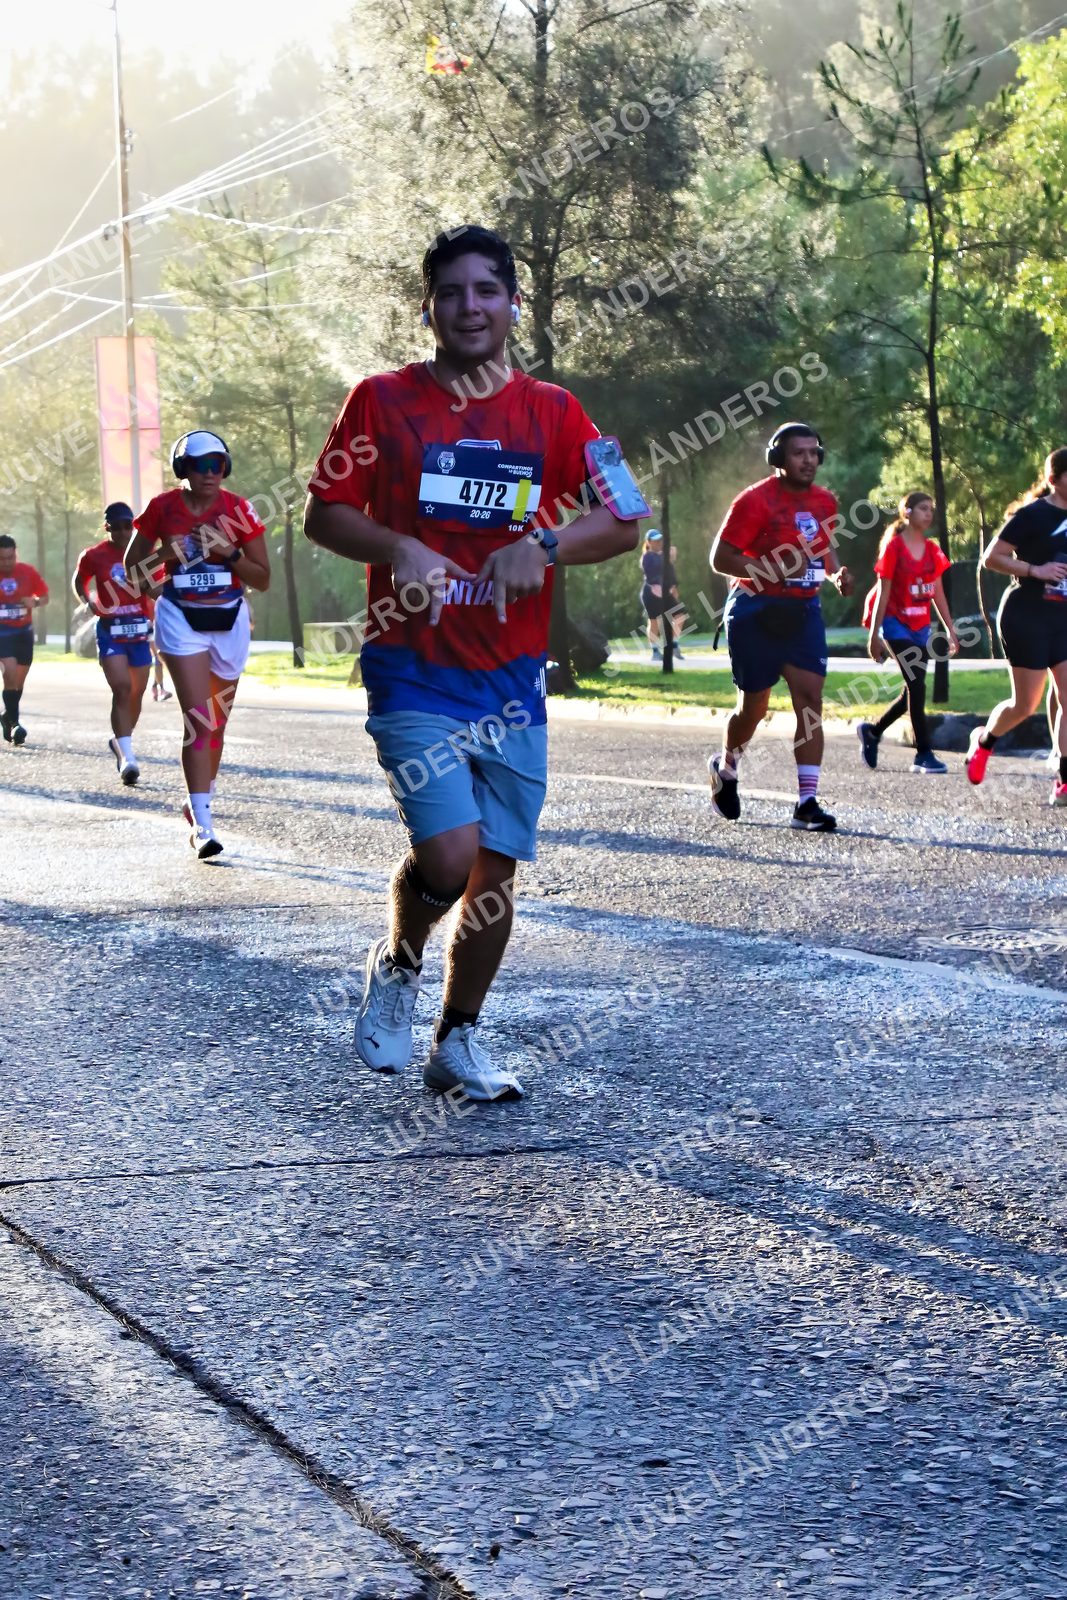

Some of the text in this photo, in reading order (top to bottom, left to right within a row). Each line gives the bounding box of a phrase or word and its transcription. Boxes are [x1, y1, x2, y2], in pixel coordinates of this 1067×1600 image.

[459, 479, 508, 508] 4772
[508, 524, 524, 532] 10K
[190, 574, 216, 586] 5299
[443, 578, 494, 606] NTIA
